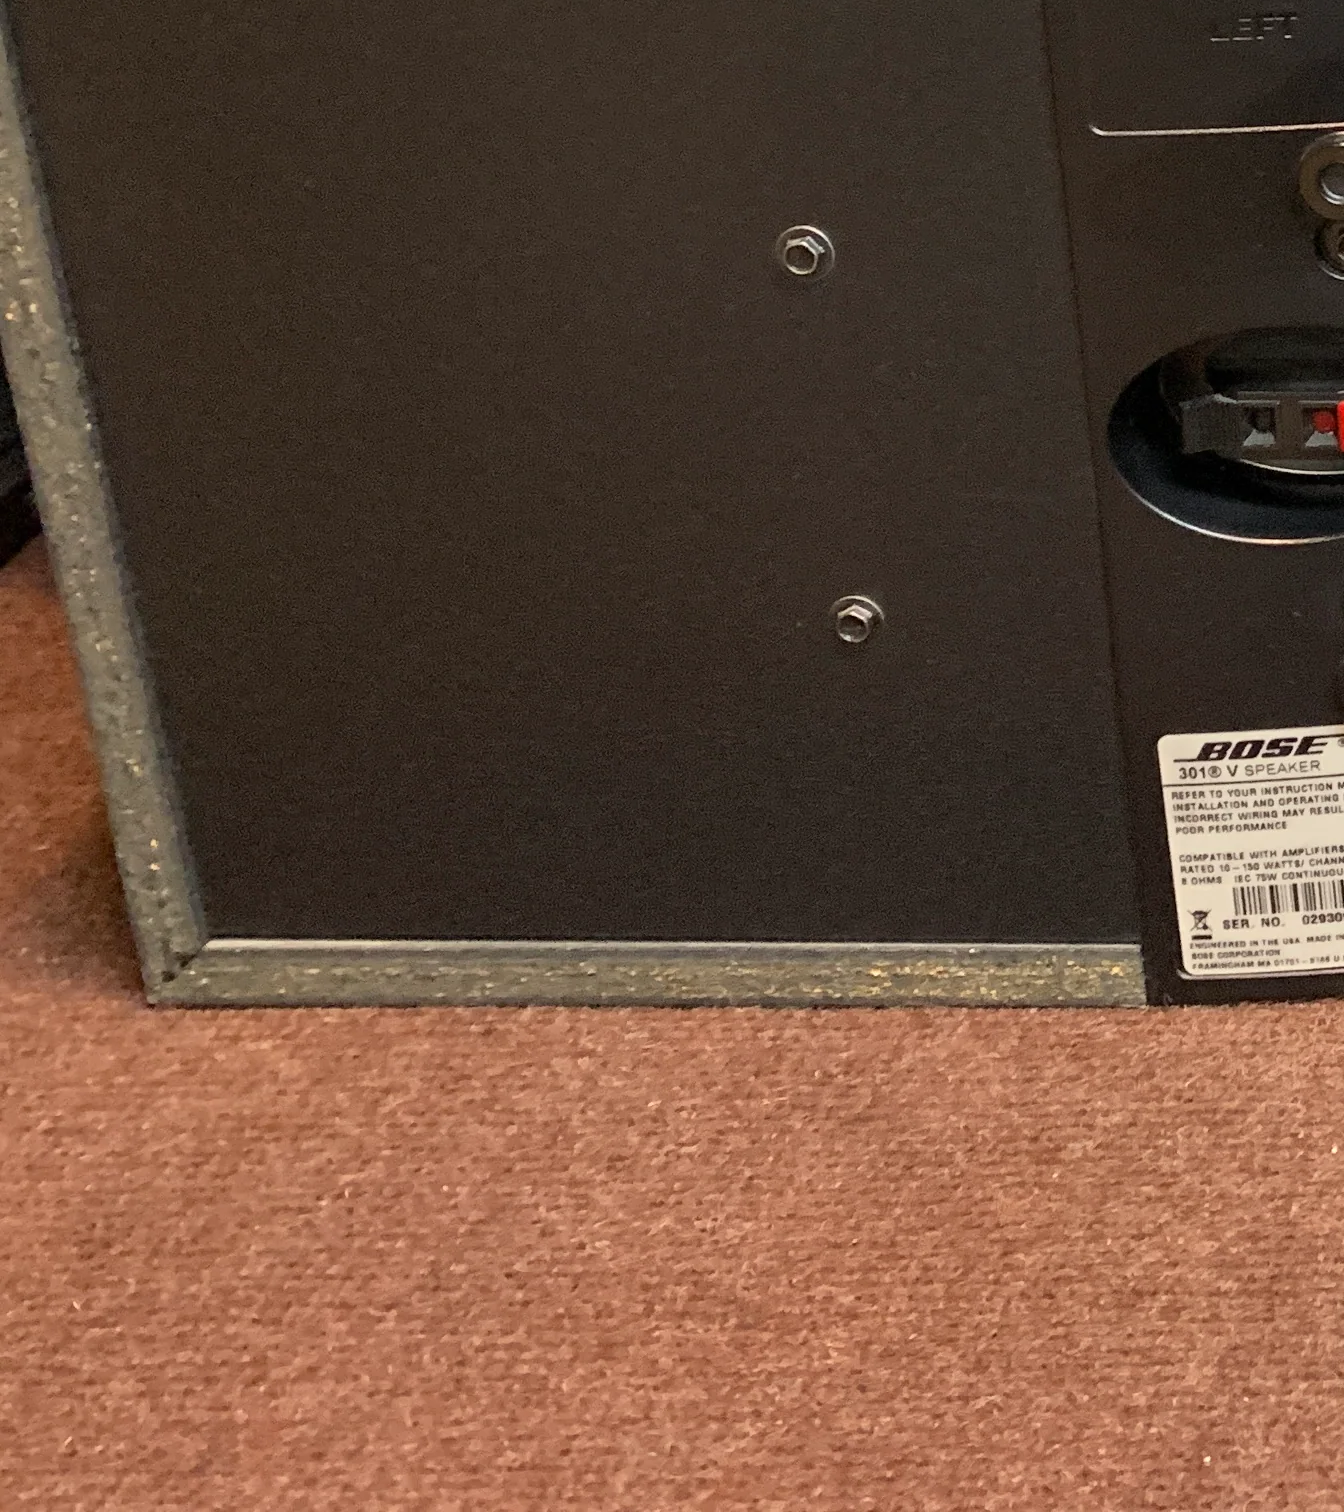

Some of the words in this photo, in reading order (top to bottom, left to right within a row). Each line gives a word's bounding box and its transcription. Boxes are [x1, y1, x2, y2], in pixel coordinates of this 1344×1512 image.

[1209, 11, 1299, 43] LEFT
[1226, 765, 1238, 777] V
[1244, 760, 1321, 776] SPEAKER
[1171, 790, 1206, 800] REFER
[1210, 790, 1223, 799] TO
[1227, 788, 1257, 798] YOUR
[1260, 783, 1333, 795] INSTRUCTION
[1172, 800, 1249, 812] INSTALLATION
[1253, 799, 1274, 808] AND
[1278, 793, 1339, 806] OPERATING
[1174, 812, 1233, 823] INCORRECT
[1238, 810, 1278, 820] WIRING
[1282, 808, 1305, 817] MAY
[1175, 825, 1204, 835] POOR
[1208, 821, 1287, 834] PERFORMANCE
[1179, 851, 1244, 863] COMPATIBLE
[1250, 850, 1277, 859] WITH
[1282, 844, 1344, 857] AMPLIFIERS
[1180, 864, 1214, 874] RATED
[1191, 876, 1223, 885] OHMS
[1234, 874, 1251, 883] IEC
[1256, 873, 1277, 882] 75W
[1190, 940, 1246, 950] ENGINEERED
[1262, 938, 1279, 946] THE
[1306, 934, 1332, 943] MADE
[1335, 933, 1344, 941] IN
[1217, 949, 1281, 959] CORPORATION
[1192, 960, 1254, 970] FRAMINGHAM
[1258, 959, 1271, 967] MA
